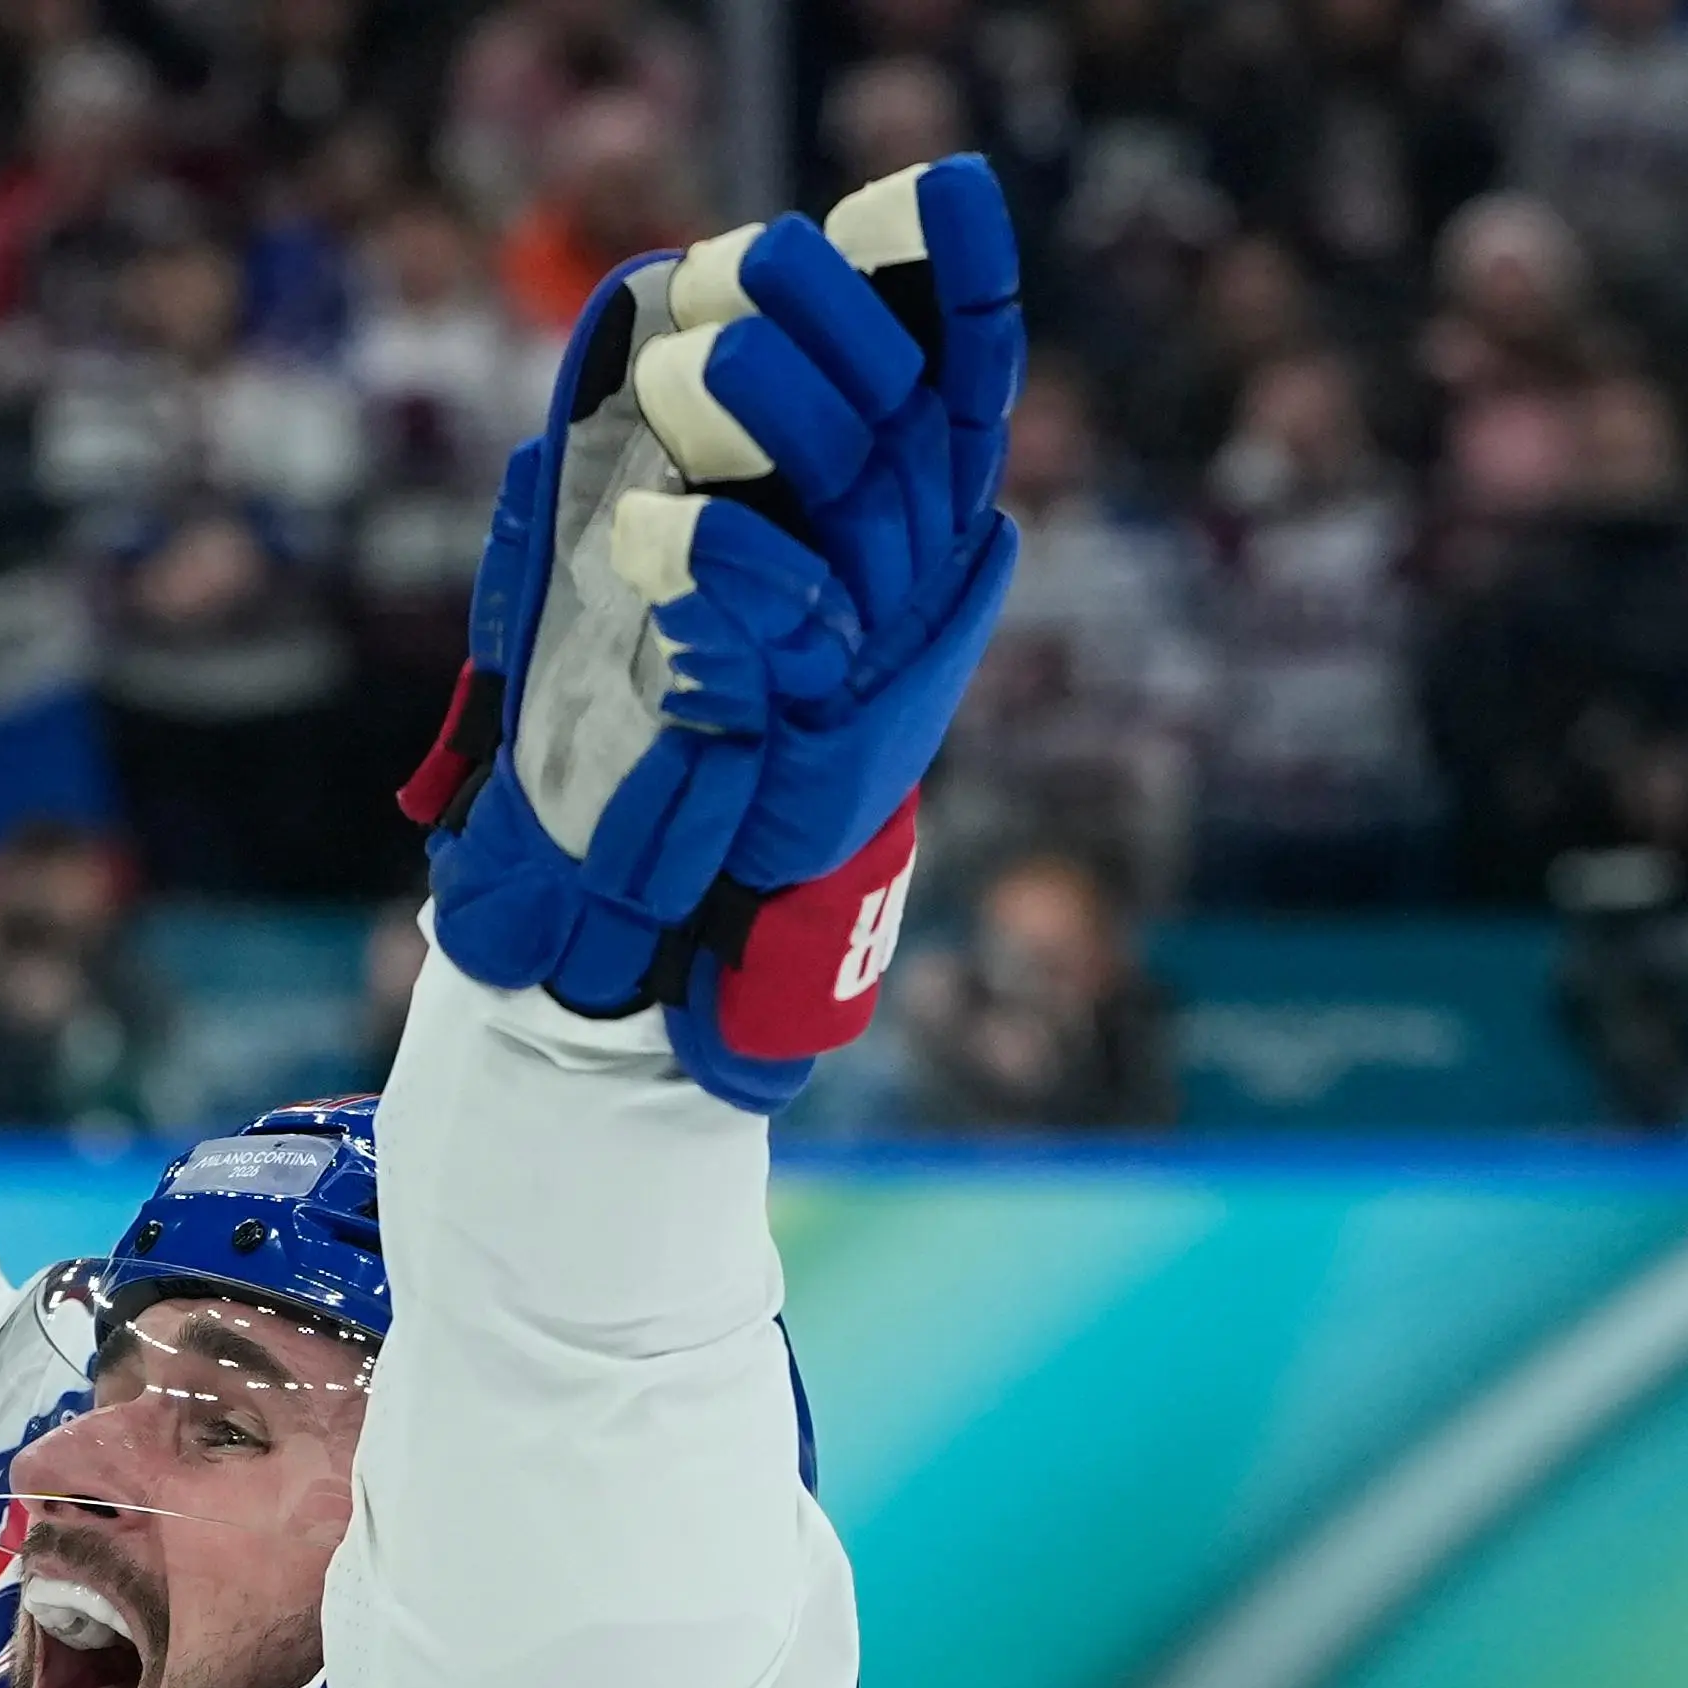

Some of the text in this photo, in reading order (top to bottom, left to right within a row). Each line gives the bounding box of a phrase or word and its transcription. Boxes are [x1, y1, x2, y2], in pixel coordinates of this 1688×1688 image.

[192, 1151, 317, 1170] MILANO CORTINA
[228, 1166, 260, 1178] 2026
